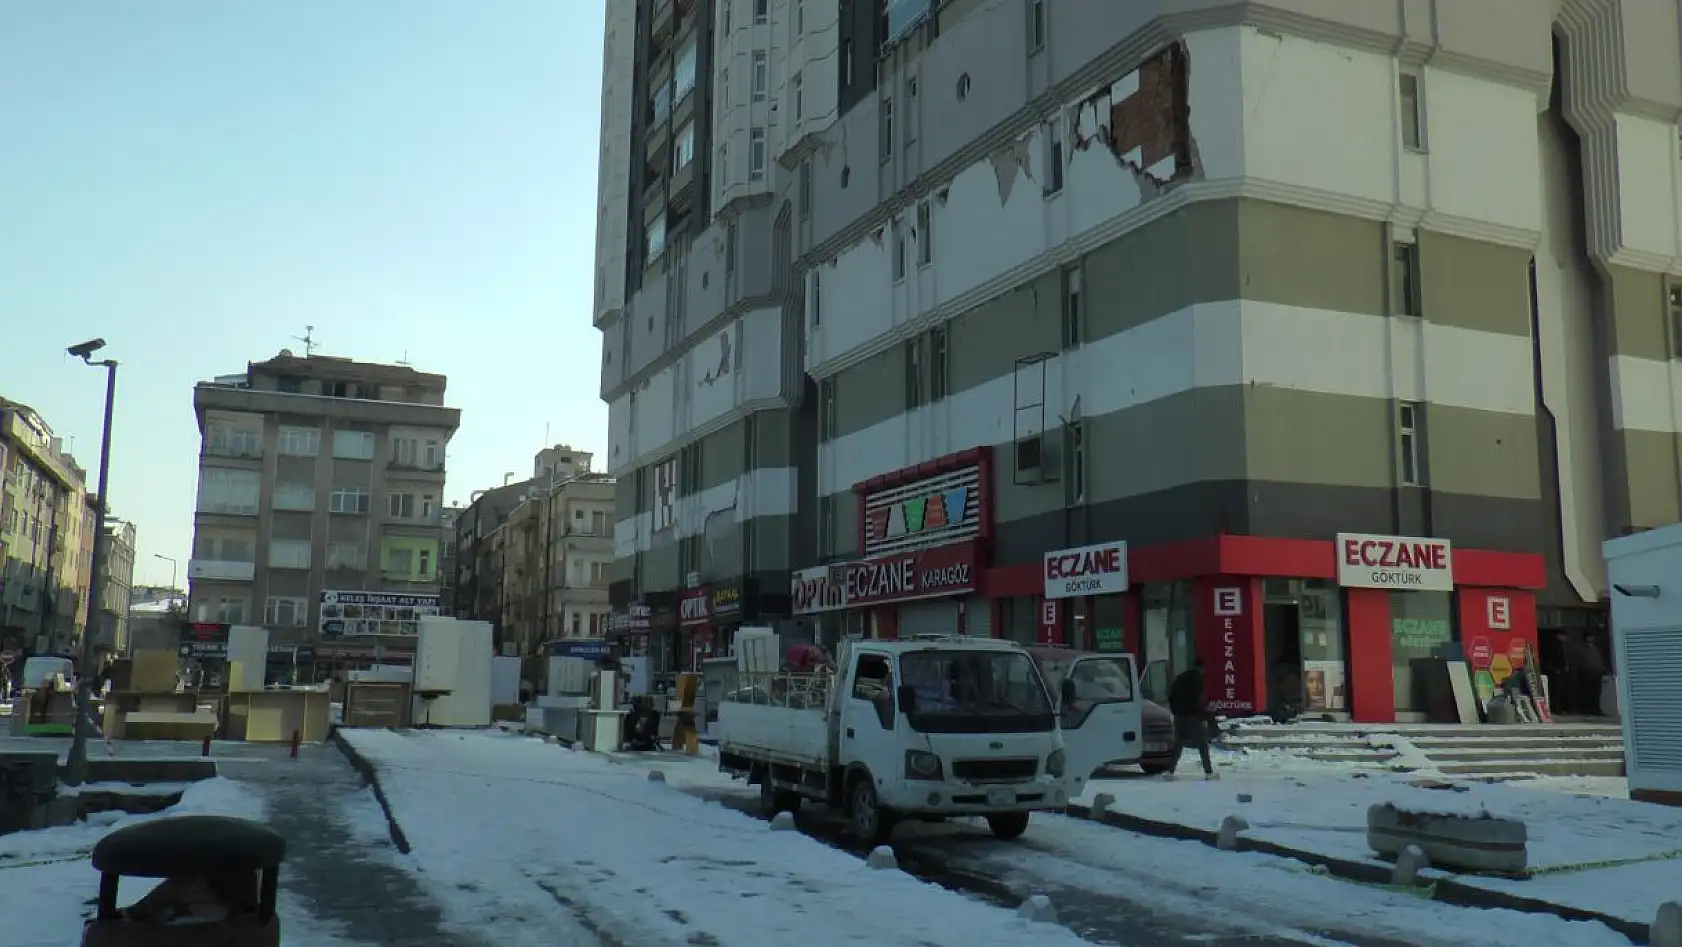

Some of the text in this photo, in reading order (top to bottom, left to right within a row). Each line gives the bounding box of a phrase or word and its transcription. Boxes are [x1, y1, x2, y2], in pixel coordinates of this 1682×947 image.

[1047, 548, 1121, 580] ECZANE
[1344, 539, 1447, 569] ECZANE
[846, 558, 969, 600] ECZANE KARAGÖZ
[1219, 591, 1236, 611] E
[1493, 602, 1506, 623] E
[1224, 618, 1236, 699] ECZANE
